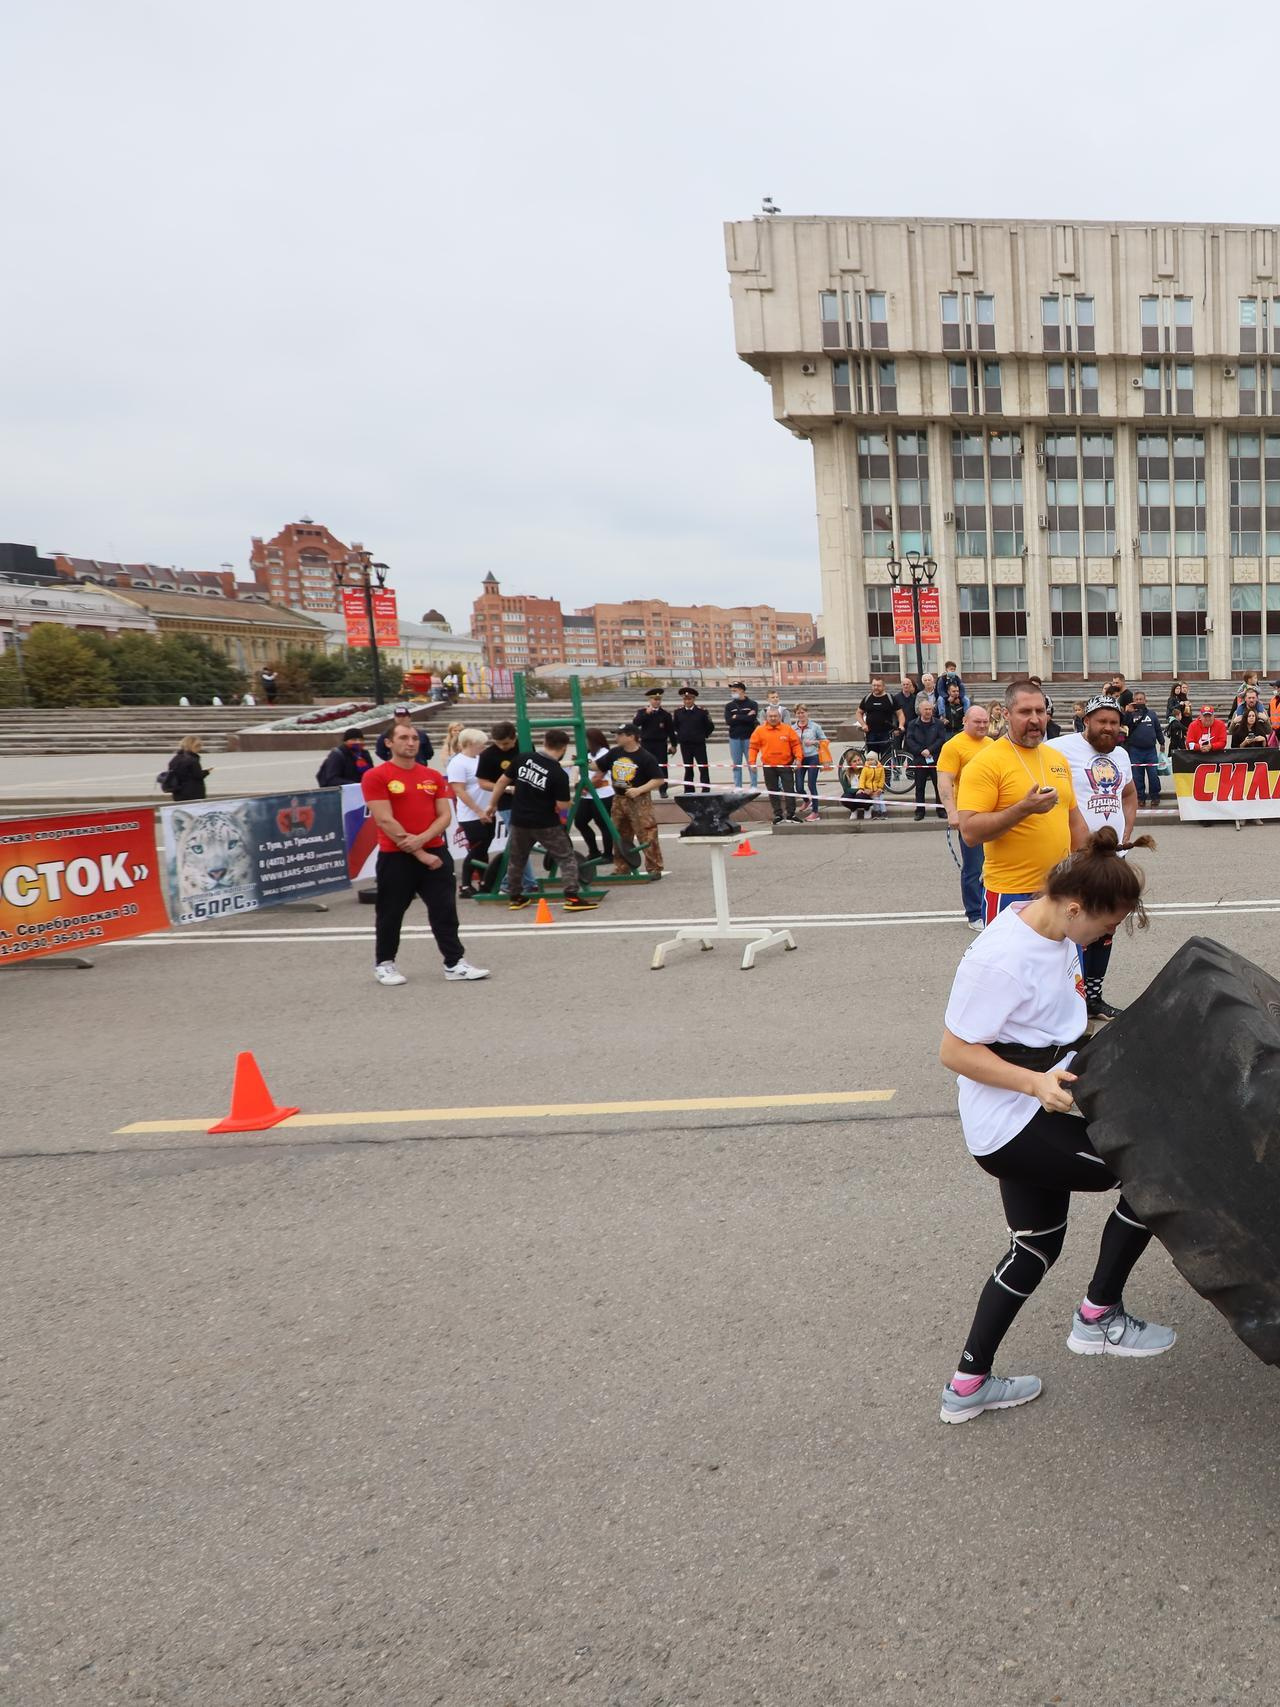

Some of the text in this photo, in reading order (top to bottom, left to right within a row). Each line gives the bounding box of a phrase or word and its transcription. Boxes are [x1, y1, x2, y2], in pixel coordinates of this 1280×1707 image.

[518, 765, 548, 789] СИЛА
[0, 833, 32, 844] ская
[17, 909, 119, 936] Серебровская
[121, 904, 138, 916] 30
